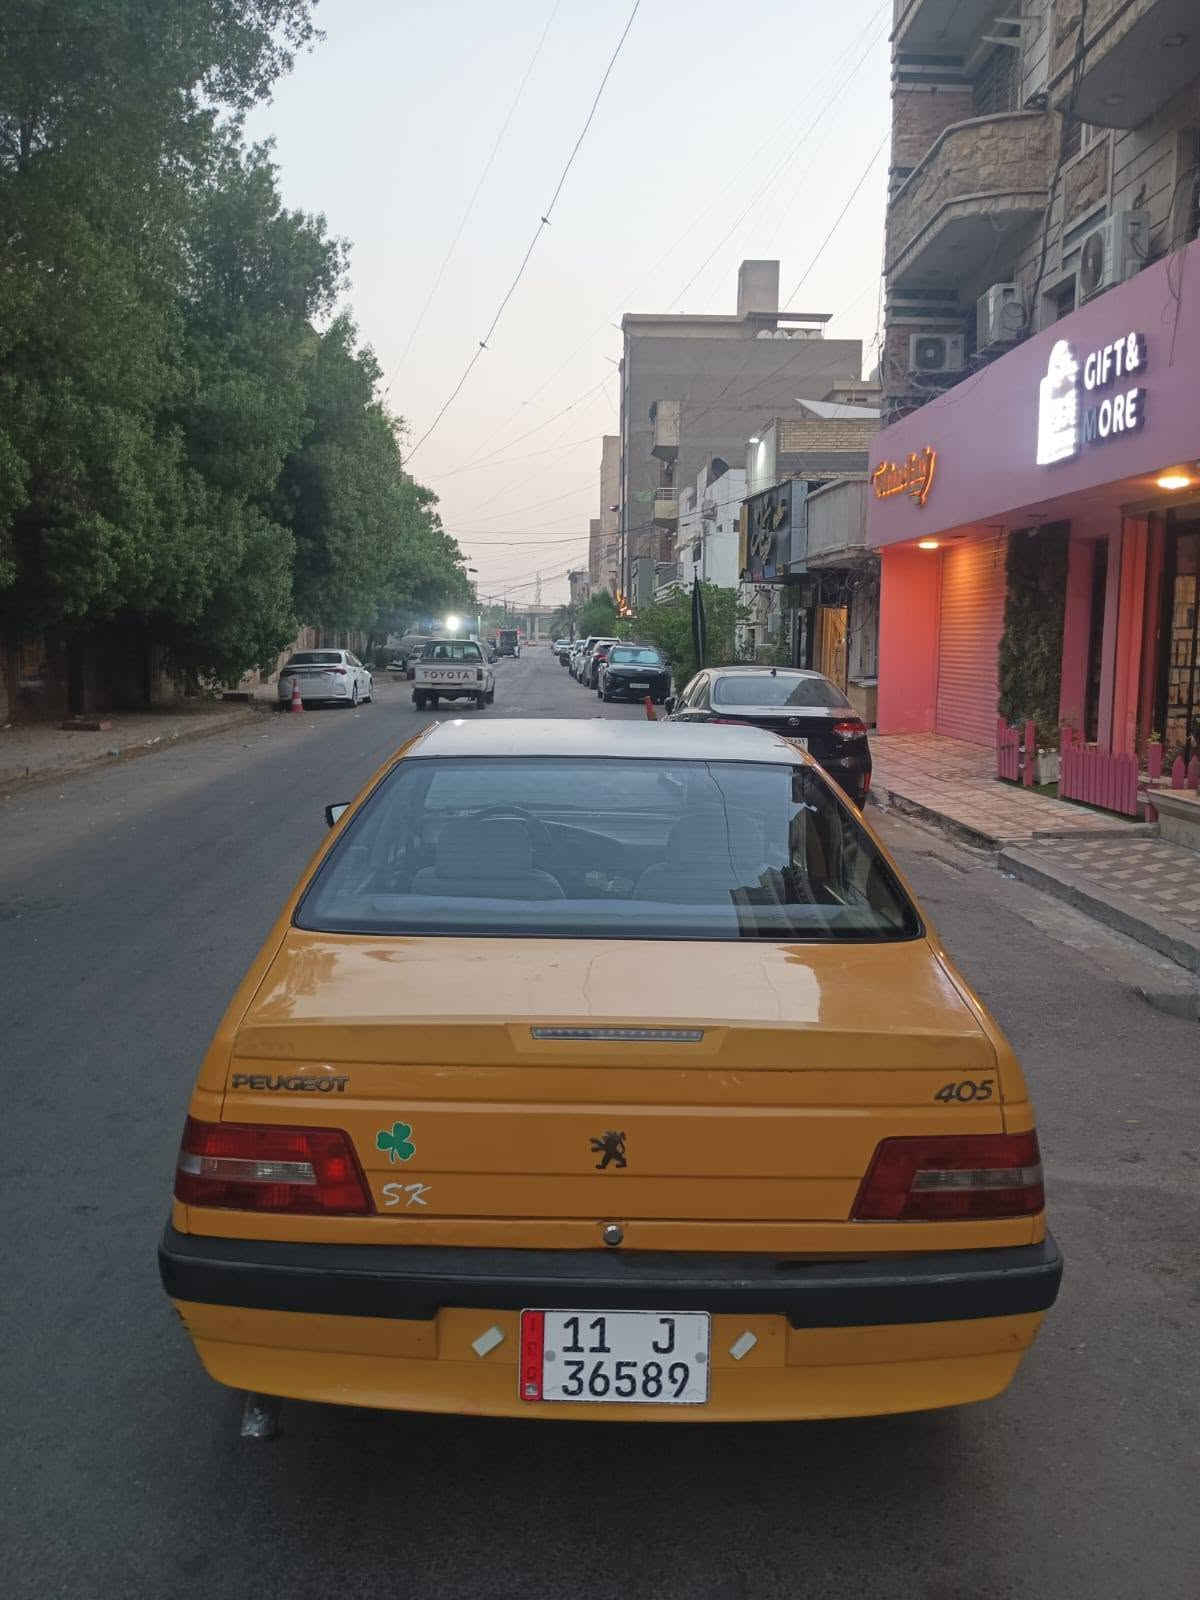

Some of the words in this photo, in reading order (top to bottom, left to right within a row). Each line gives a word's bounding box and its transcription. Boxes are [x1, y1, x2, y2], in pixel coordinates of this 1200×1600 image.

[1081, 387, 1138, 442] MORE
[424, 671, 470, 679] TOYOTA
[232, 1074, 349, 1092] PEUGEOT
[933, 1080, 993, 1103] 405
[562, 1316, 611, 1353] 11
[652, 1318, 675, 1354] J
[561, 1360, 690, 1398] 36589
